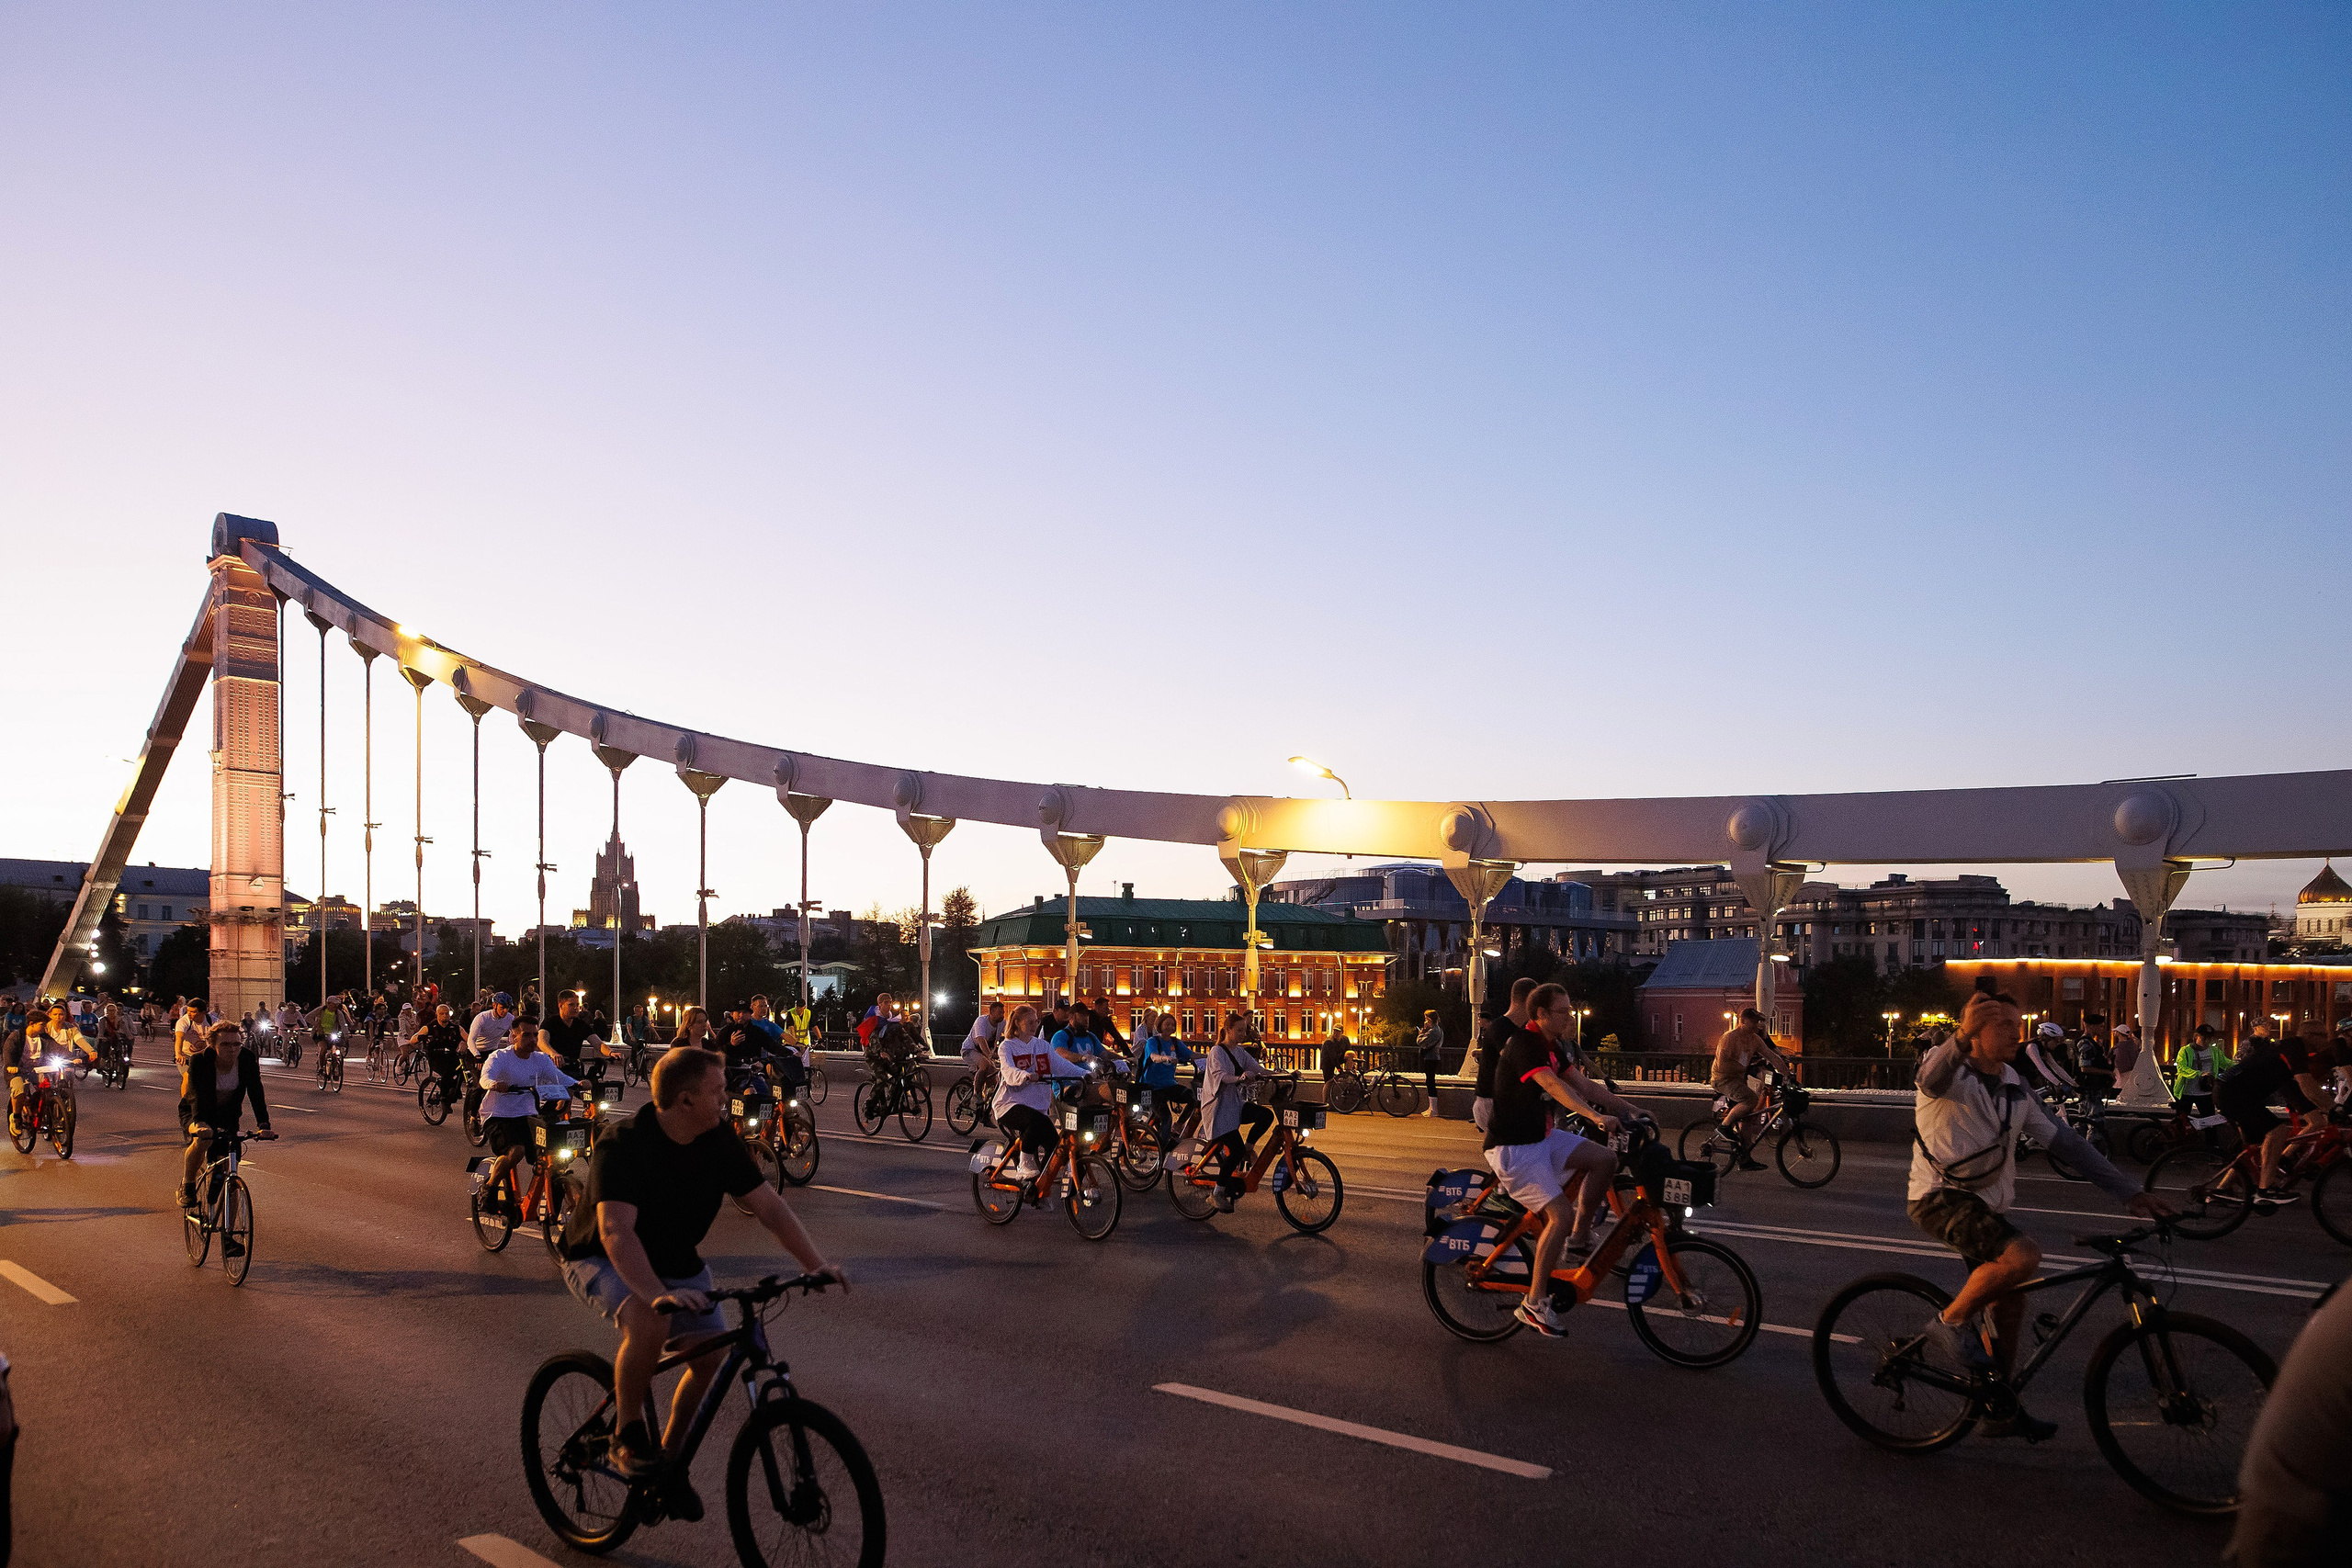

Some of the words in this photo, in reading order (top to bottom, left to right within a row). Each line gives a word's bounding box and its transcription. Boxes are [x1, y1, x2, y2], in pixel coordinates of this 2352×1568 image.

[1284, 1111, 1298, 1119] AA2
[1283, 1118, 1297, 1126] 86E
[567, 1131, 584, 1139] AA2
[1665, 1179, 1691, 1192] AA1
[1445, 1187, 1463, 1197] ВТБ
[1664, 1190, 1690, 1202] 38B
[1449, 1238, 1470, 1251] ВТБ
